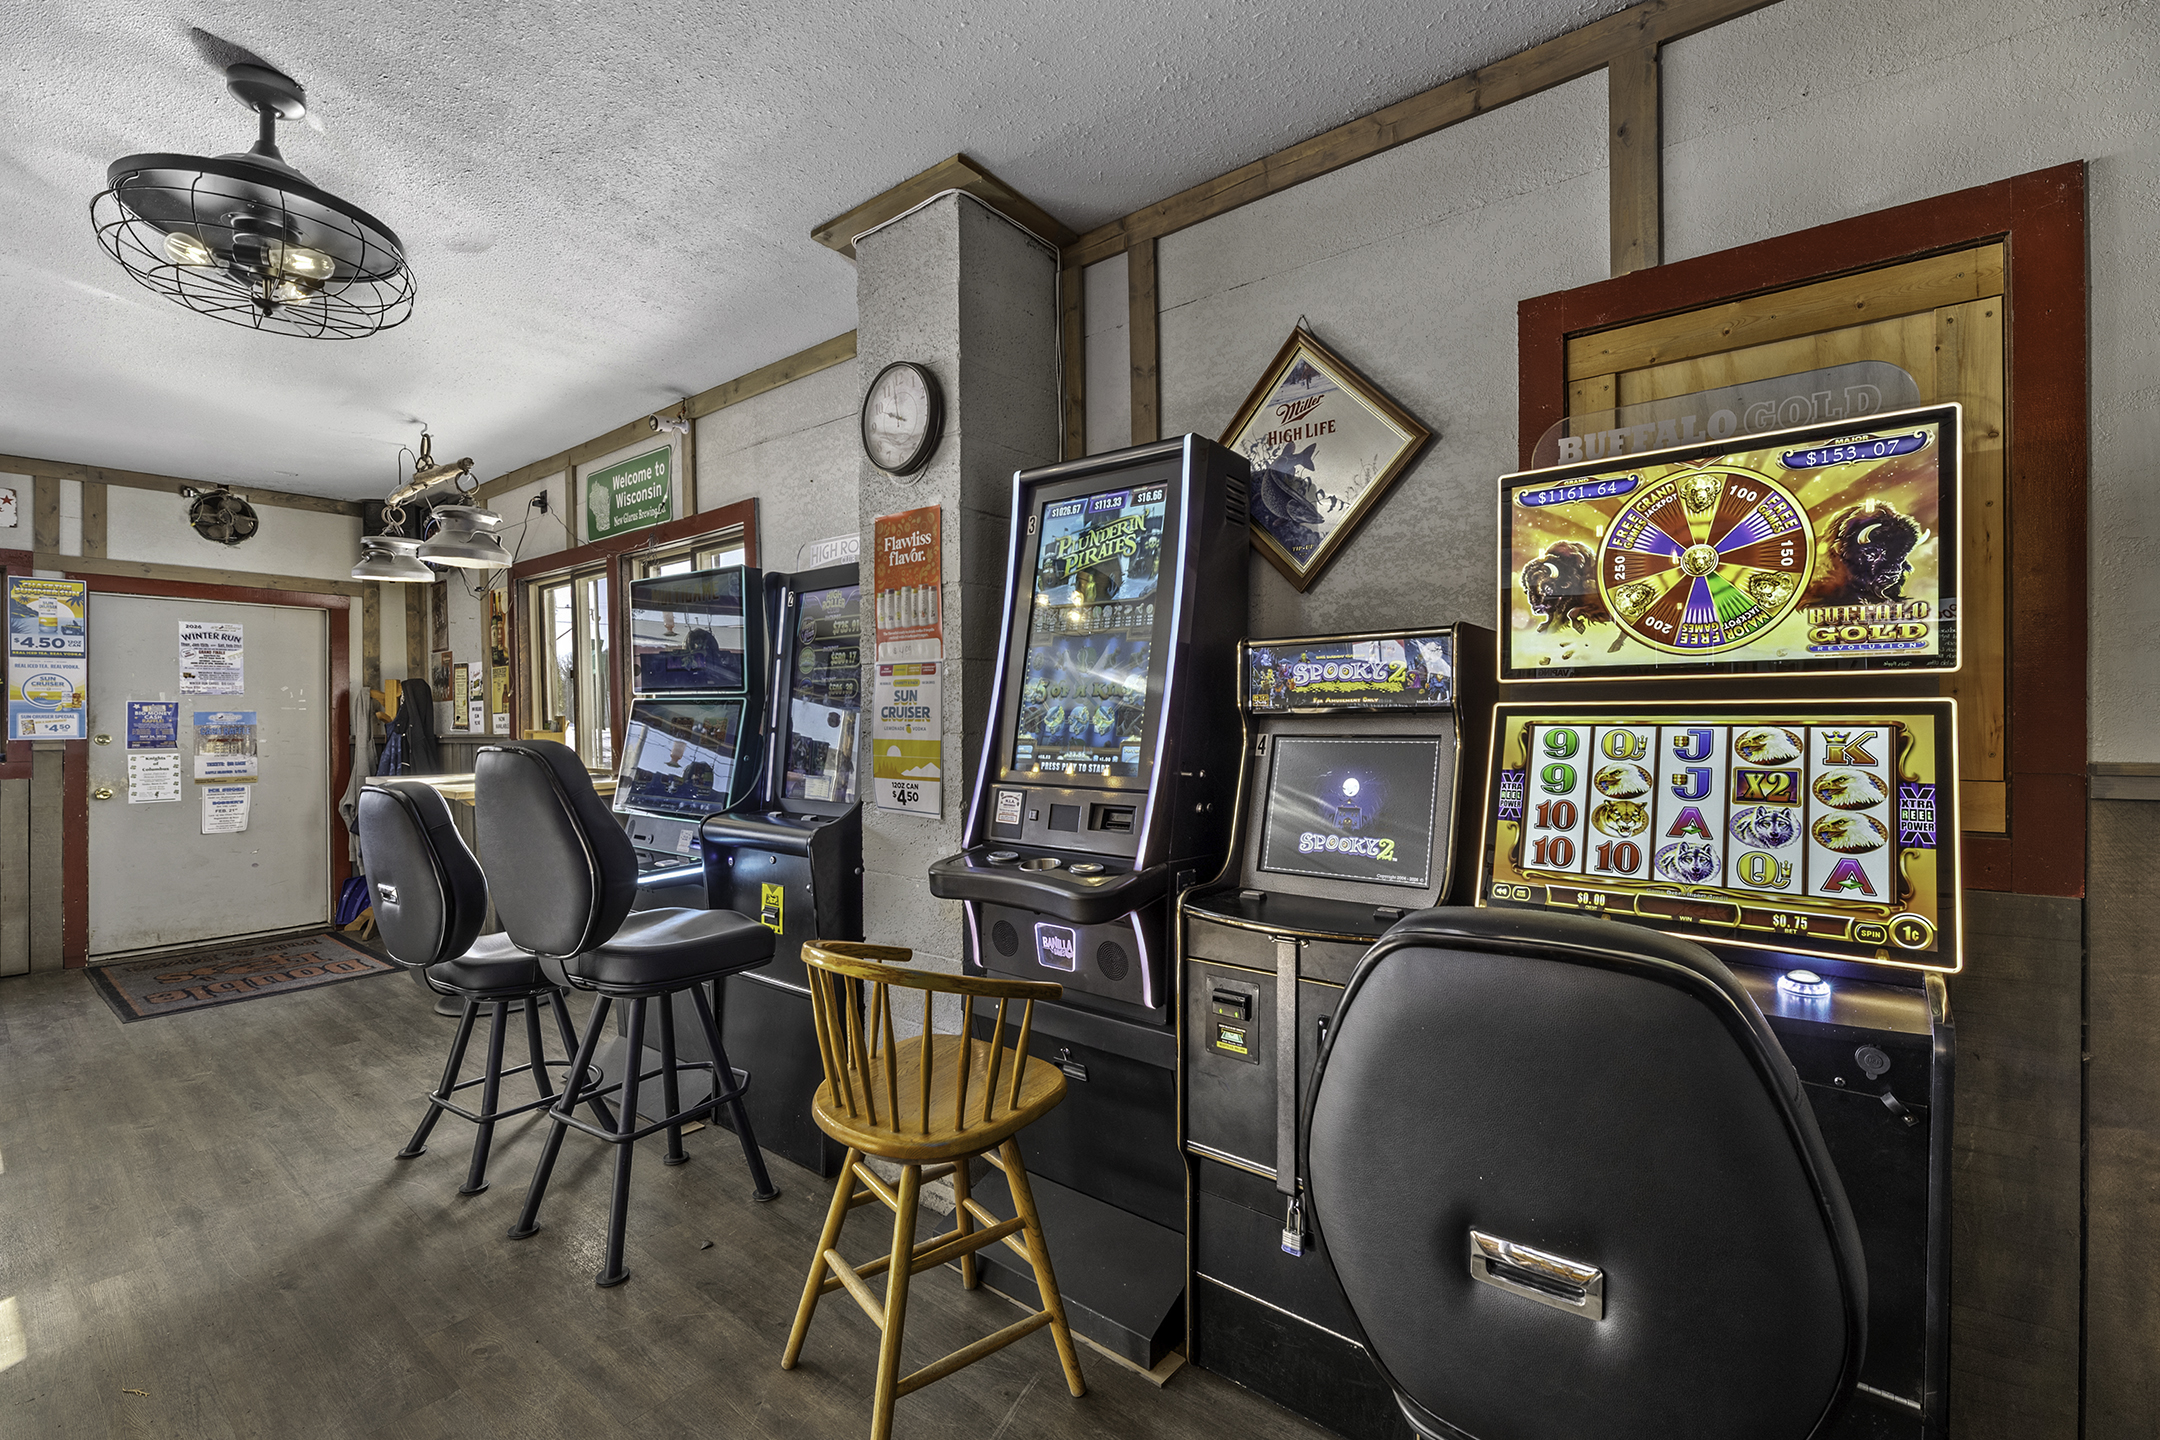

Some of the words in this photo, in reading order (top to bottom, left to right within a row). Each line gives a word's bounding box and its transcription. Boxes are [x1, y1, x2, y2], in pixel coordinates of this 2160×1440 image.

[883, 385, 891, 398] 11
[875, 402, 883, 415] 10
[1275, 394, 1325, 426] Miller
[871, 422, 877, 434] 9
[1268, 423, 1302, 446] HIGH
[1305, 419, 1336, 439] LIFE
[1558, 409, 1738, 466] BUFFALO
[1743, 384, 1881, 430] GOLD
[1835, 436, 1869, 444] MAJOR
[886, 451, 891, 463] 7
[1806, 440, 1899, 466] $153.07
[612, 467, 652, 491] Welcome
[655, 461, 665, 477] to
[615, 482, 662, 509] Wisconsin
[1094, 496, 1122, 510] $113.33
[1138, 490, 1162, 503] $16.66
[1538, 482, 1616, 504] $1161.64
[1636, 483, 1676, 512] GRAND
[1729, 485, 1757, 501] 100
[1052, 504, 1081, 518] $1026.67
[1644, 493, 1678, 518] JACKPOT
[1766, 495, 1799, 528] FREE
[613, 516, 623, 527] New
[623, 512, 638, 523] Glarus
[638, 506, 658, 519] Brewing
[1029, 517, 1036, 534] 3
[1757, 505, 1784, 534] GAMES
[1056, 509, 1149, 558] PLUNDERIN'
[1612, 513, 1639, 546] FREE
[1624, 518, 1647, 549] GAMES
[884, 531, 931, 552] Flawliss
[811, 542, 838, 566] HIGH
[841, 555, 856, 564] CLUB
[889, 547, 926, 566] flavor.
[1060, 534, 1137, 579] PIRATES
[1780, 539, 1793, 566] 150
[1614, 555, 1625, 581] 250
[15, 588, 58, 596] SUMMER
[22, 582, 54, 590] CHASE
[826, 590, 842, 600] HIGH
[822, 598, 845, 610] ROLLER
[1809, 601, 1930, 625] BUFFALO
[1645, 616, 1673, 634] 200
[1682, 622, 1719, 632] GAMES
[1723, 605, 1760, 630] JACKPOT
[1726, 611, 1769, 640] MAJOR
[14, 637, 65, 648] $4.50
[181, 632, 220, 641] WINTER
[221, 633, 241, 643] RUN
[1680, 633, 1720, 644] FREE
[1808, 622, 1929, 643] GOLD
[1818, 643, 1917, 651] REVOLUTION
[1292, 661, 1389, 686] SPOOKY
[1388, 660, 1407, 683] 2
[894, 690, 917, 702] SUN
[1033, 681, 1049, 703] 5
[1051, 683, 1071, 698] OF
[1073, 684, 1087, 698] A
[881, 706, 930, 718] CRUISER
[200, 727, 221, 735] CASH
[223, 727, 250, 735] RAFFLE
[1258, 735, 1266, 755] 4
[1543, 728, 1579, 760] 9
[1601, 728, 1646, 760] Q
[1673, 729, 1714, 762] J
[1822, 731, 1878, 766] K
[1041, 761, 1060, 771] PRESS
[1061, 763, 1076, 772] PLAY
[1078, 764, 1086, 772] TO
[1088, 764, 1110, 773] START
[1540, 763, 1577, 795] 9
[1671, 767, 1712, 801] J
[1743, 771, 1791, 801] X2
[1500, 800, 1522, 808] POWER
[1501, 791, 1522, 799] REEL
[1902, 800, 1934, 809] XTRA
[1534, 799, 1578, 832] 10
[1666, 806, 1713, 840] A
[1902, 810, 1933, 821] REEL
[1901, 822, 1934, 831] POWER
[1299, 832, 1380, 858] SPOOKY
[1376, 838, 1396, 861] 2
[1531, 835, 1575, 868] 10
[1595, 840, 1642, 874] 10
[1736, 851, 1791, 889] Q
[1820, 858, 1877, 896] A
[1577, 892, 1605, 906] $0.00
[1773, 914, 1807, 930] $0.75
[1042, 936, 1073, 952] BANILLA
[1861, 929, 1881, 939] SPIN
[1902, 926, 1920, 942] 1¢
[144, 958, 375, 1005] Double
